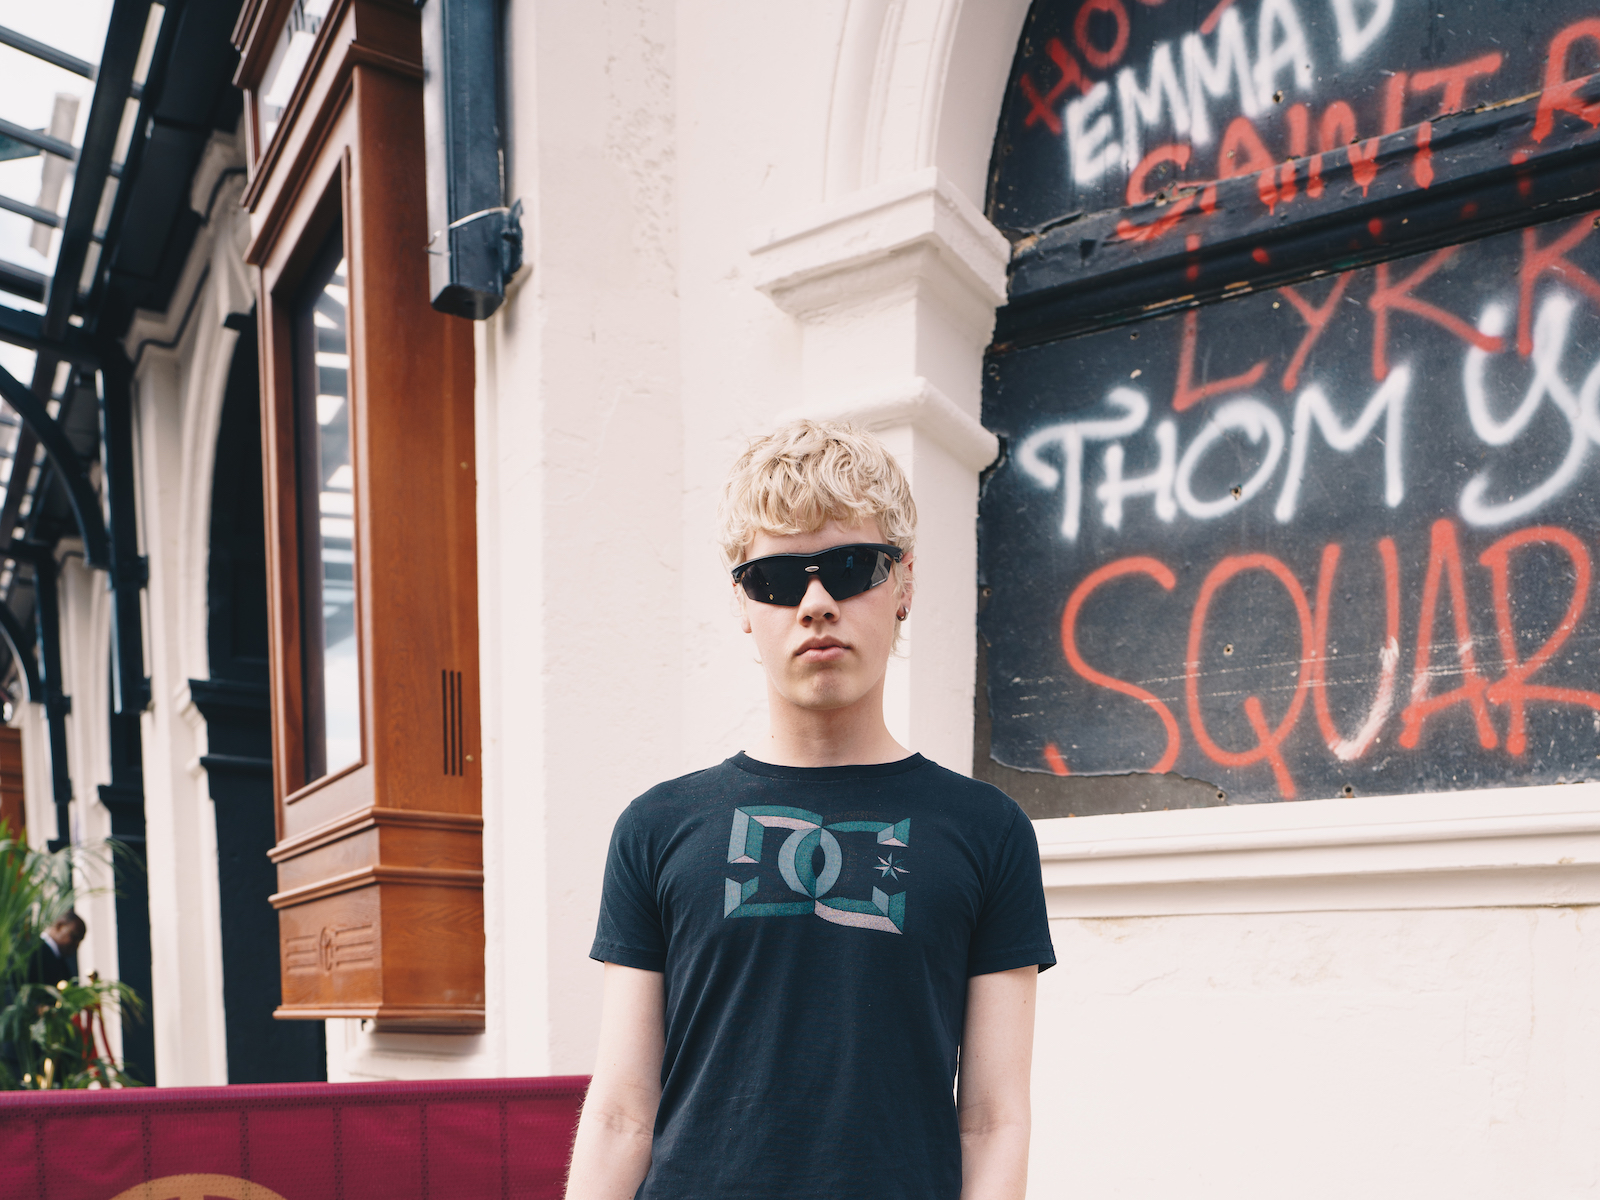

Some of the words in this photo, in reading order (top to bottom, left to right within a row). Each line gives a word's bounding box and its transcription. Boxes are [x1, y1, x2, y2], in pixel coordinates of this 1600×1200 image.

[1063, 0, 1314, 186] EMMA
[1117, 52, 1501, 243] SAINT
[1015, 364, 1412, 541] THOM
